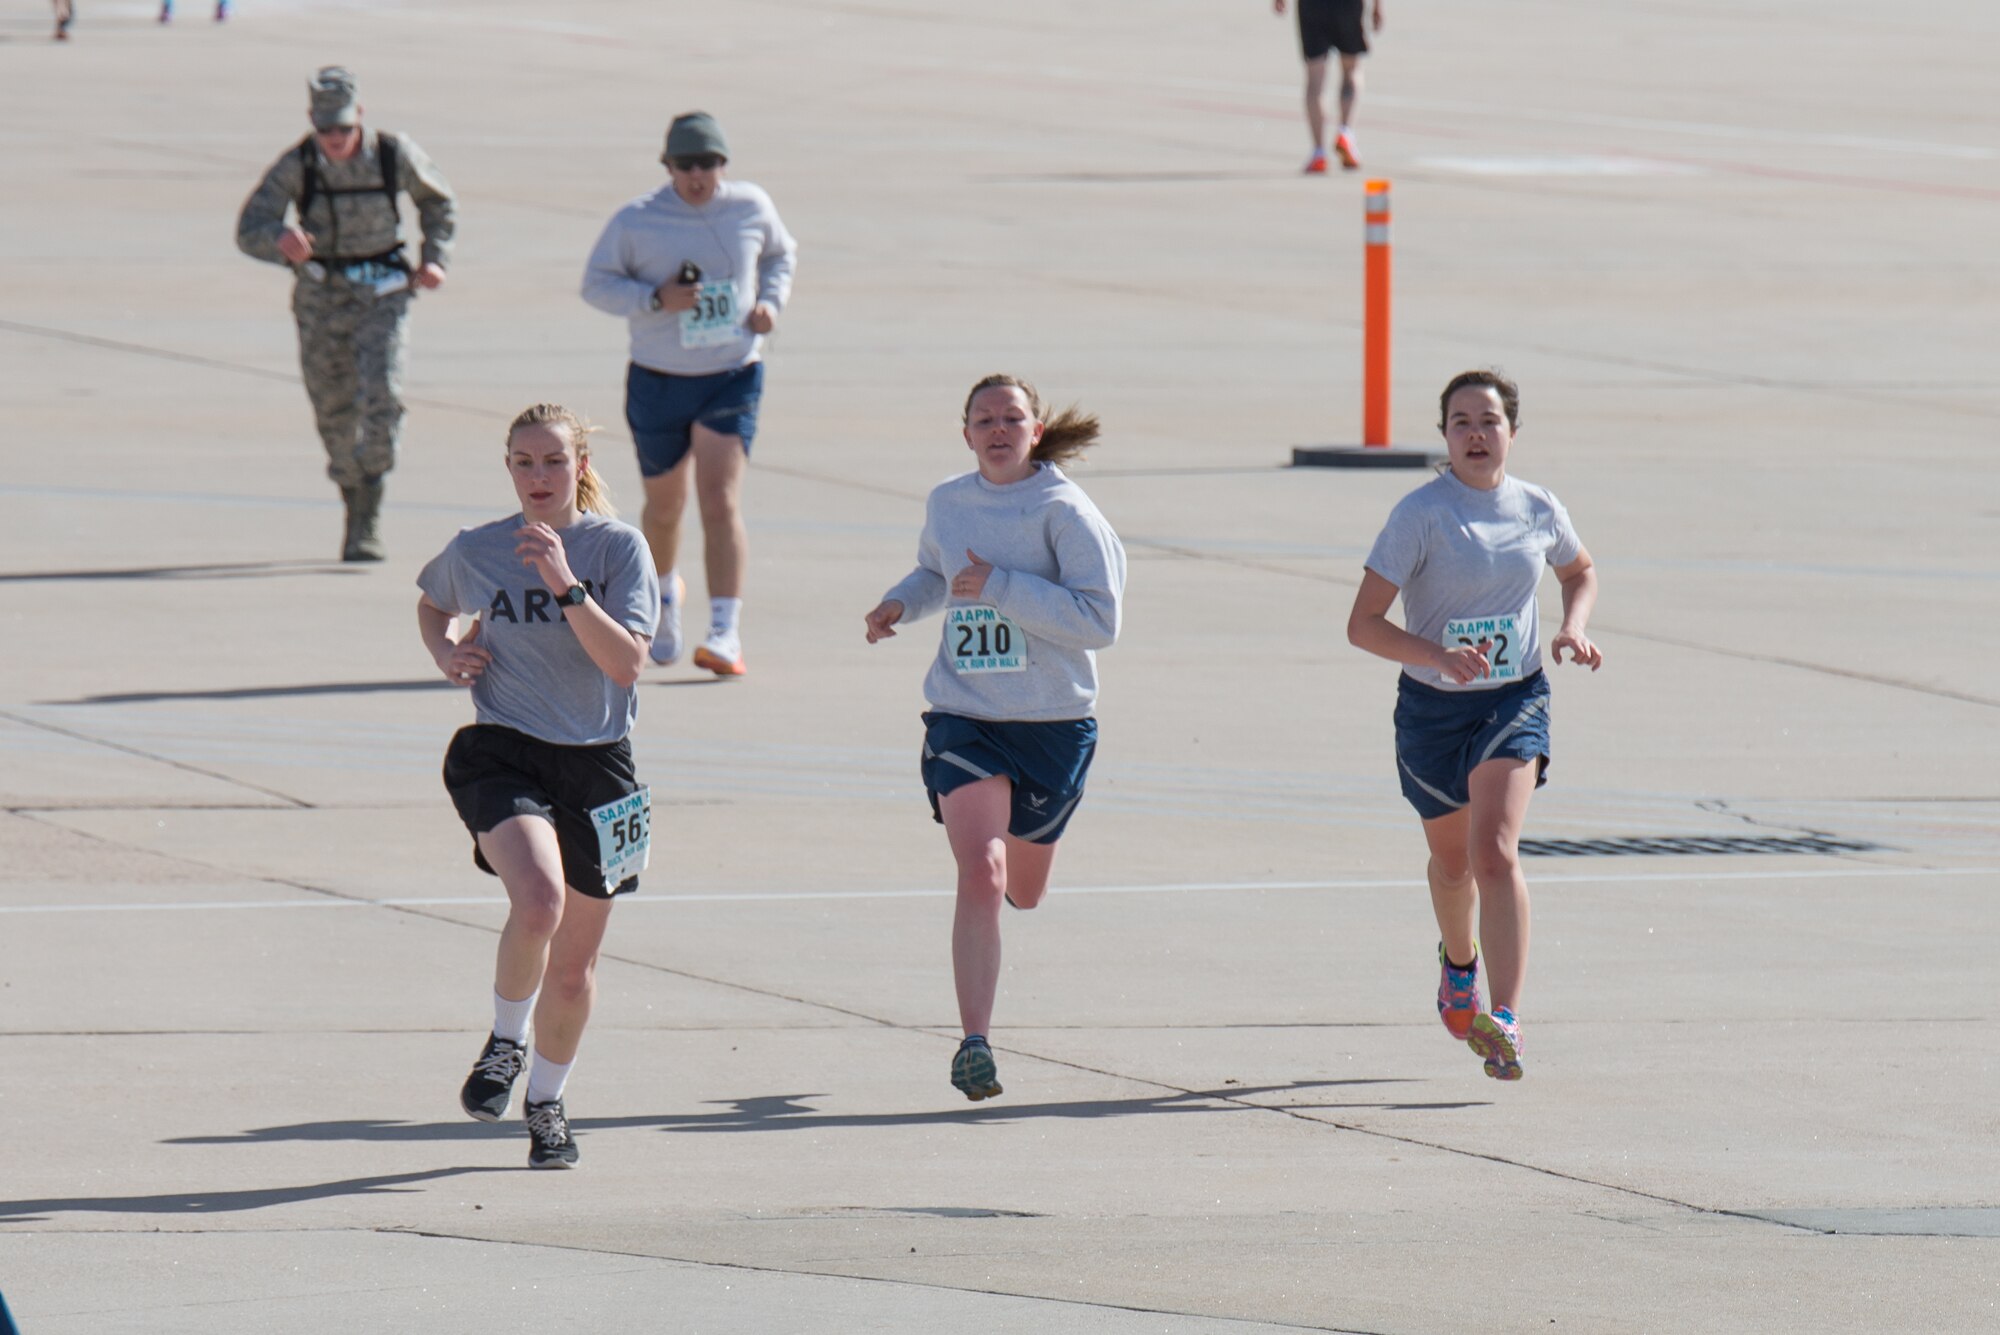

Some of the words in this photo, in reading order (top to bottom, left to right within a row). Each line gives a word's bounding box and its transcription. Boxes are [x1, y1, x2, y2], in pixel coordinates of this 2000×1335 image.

[1448, 620, 1495, 634] SAAPM
[1499, 617, 1513, 631] 5K
[956, 623, 1011, 657] 210
[999, 656, 1020, 668] WALK
[598, 795, 643, 825] SAAPM
